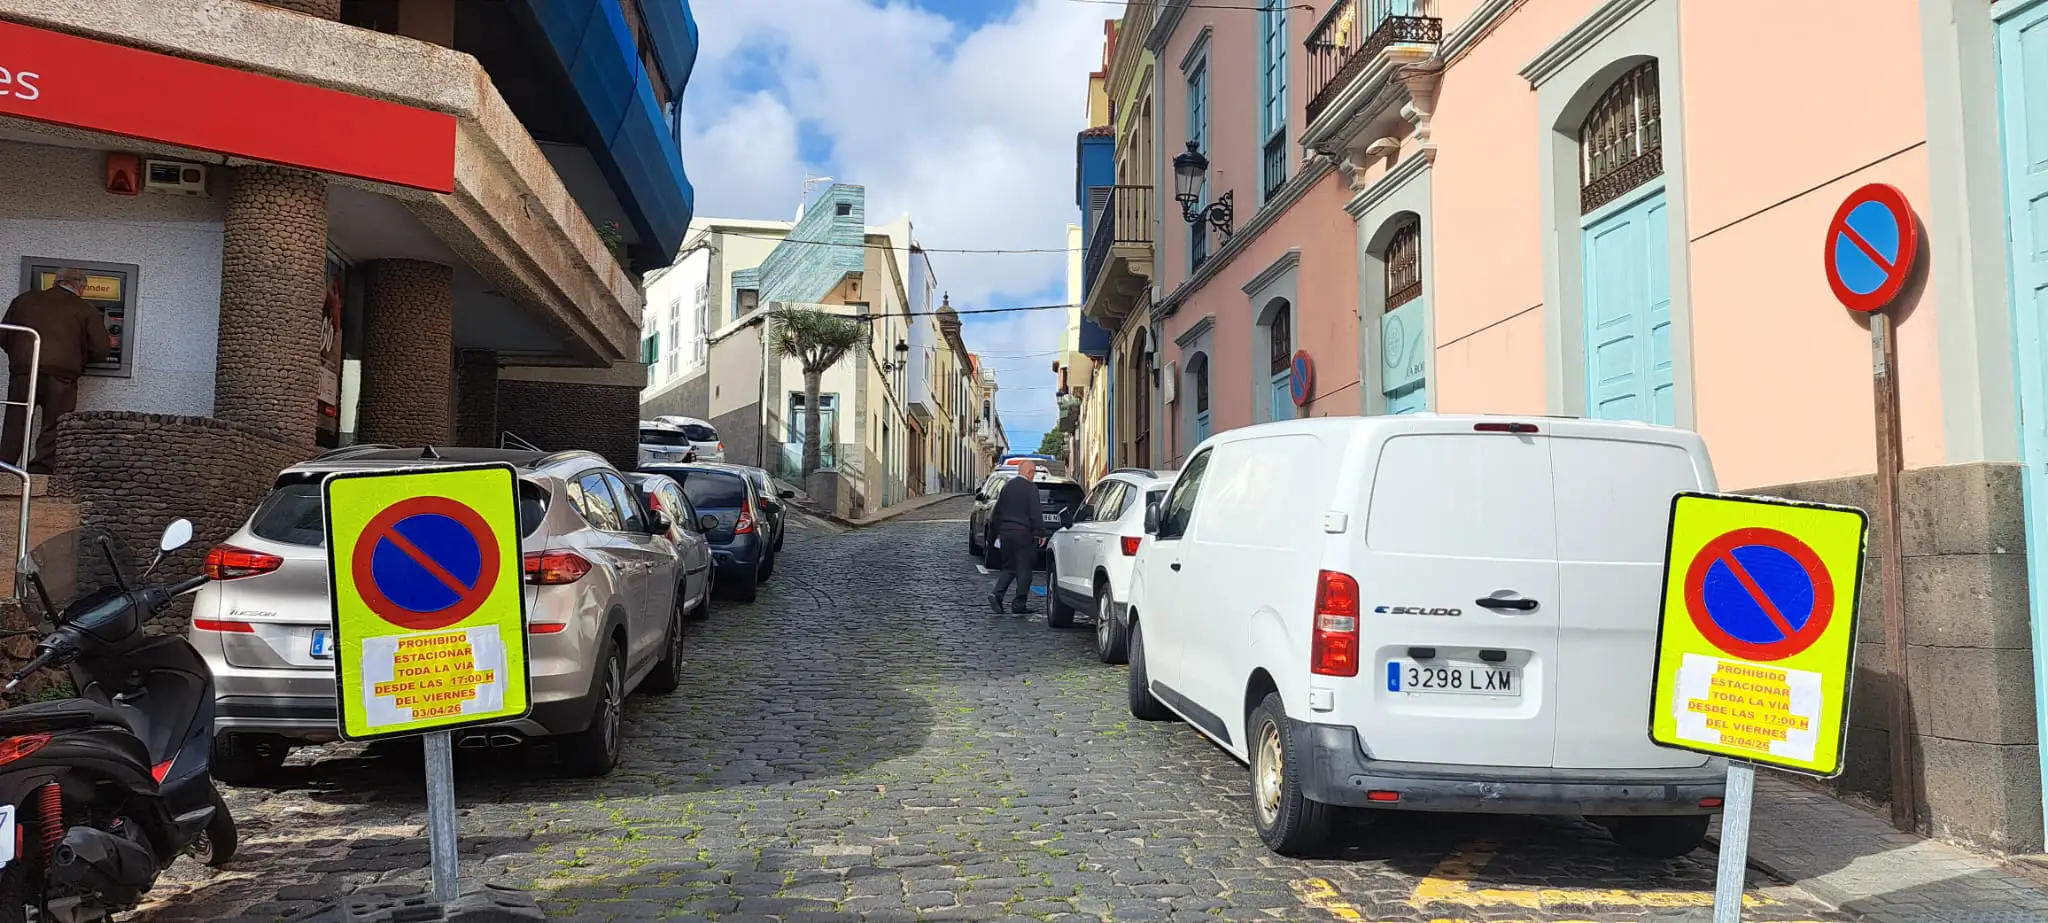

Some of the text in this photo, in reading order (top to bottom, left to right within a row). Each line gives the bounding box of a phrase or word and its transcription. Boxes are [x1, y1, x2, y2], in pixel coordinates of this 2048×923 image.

[399, 634, 467, 649] PROHIBIDO
[394, 647, 473, 664] ESTACIONAR
[398, 667, 430, 677] TODA
[435, 665, 450, 673] LA
[1407, 667, 1511, 691] 3298 LXM
[1717, 664, 1786, 682] PROHIBIDO
[375, 672, 494, 695] DESDE LAS 17:00 H
[1711, 677, 1790, 697] ESTACIONAR
[395, 688, 476, 706] DEL VIERNES
[1712, 691, 1745, 703] TODA
[1749, 697, 1764, 707] LA
[412, 704, 461, 718] 03/04/26
[1688, 701, 1809, 728] DESDE LAS 17:00 H
[1706, 718, 1787, 739] DEL VIERNES
[1720, 734, 1770, 750] 03/04/26
